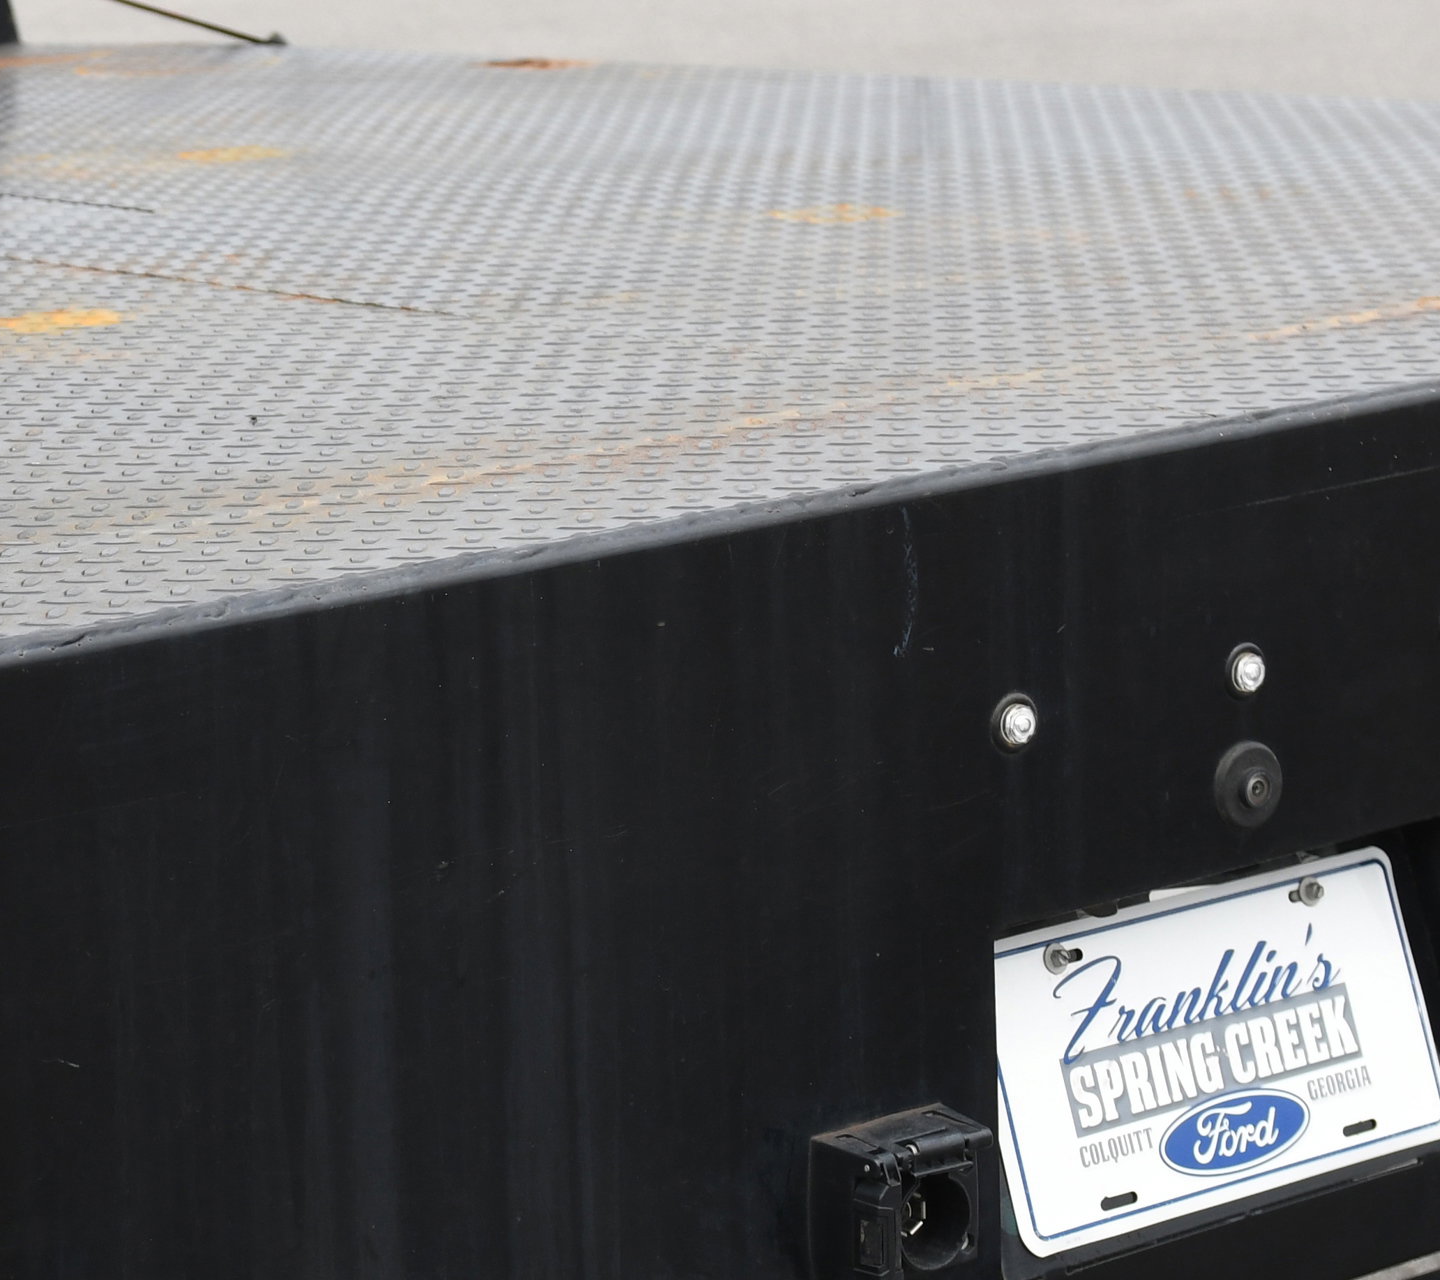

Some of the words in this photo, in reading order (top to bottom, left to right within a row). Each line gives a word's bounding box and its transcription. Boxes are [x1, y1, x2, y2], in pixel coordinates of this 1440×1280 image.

[1052, 922, 1342, 1065] Franklin's
[1068, 1030, 1226, 1130] SPRING
[1224, 995, 1360, 1084] CREEK
[1079, 1127, 1155, 1169] COLQUITT
[1192, 1099, 1280, 1165] Ford
[1306, 1065, 1373, 1102] GEORGIA
